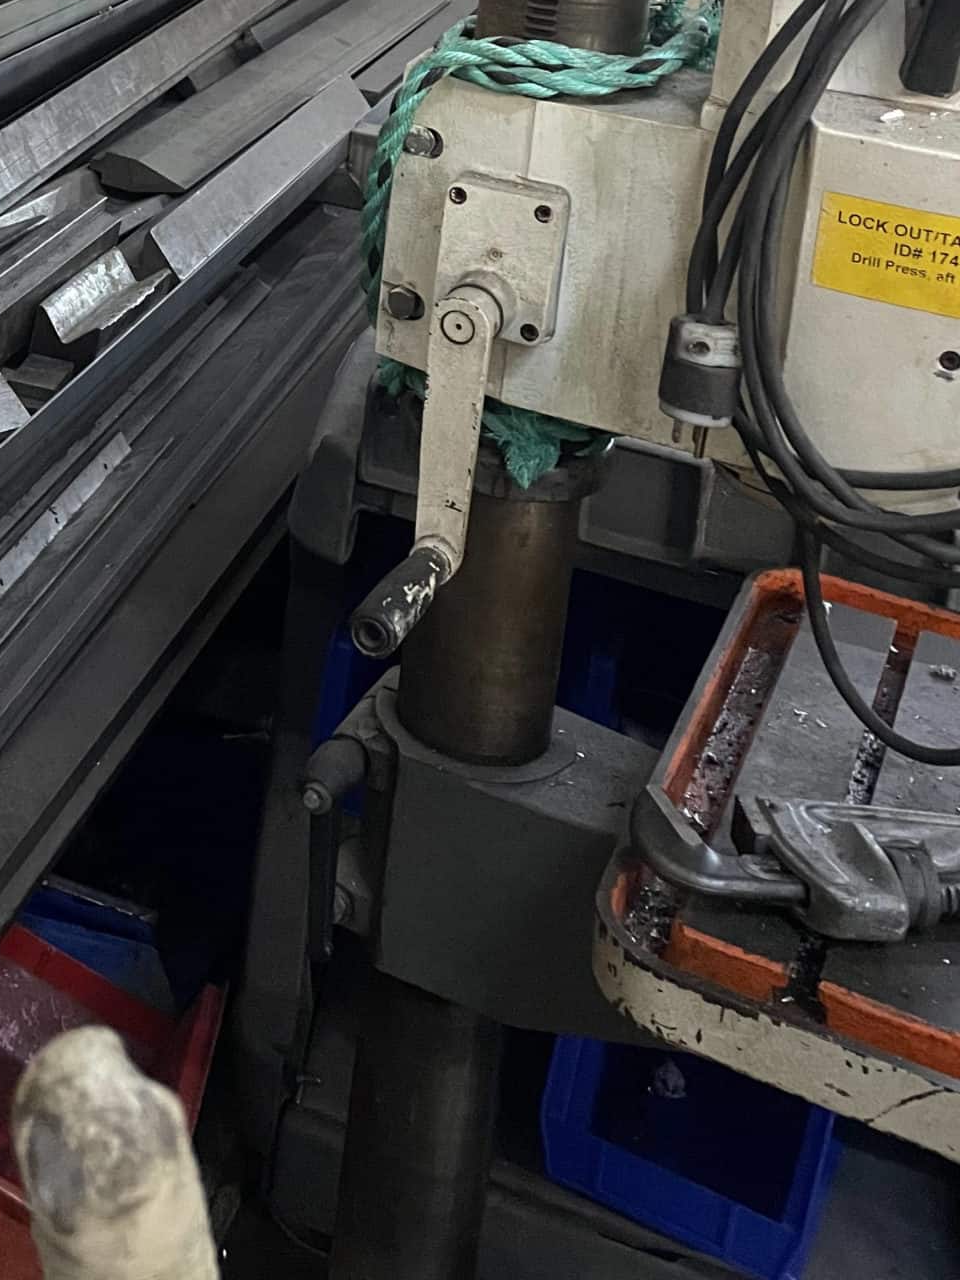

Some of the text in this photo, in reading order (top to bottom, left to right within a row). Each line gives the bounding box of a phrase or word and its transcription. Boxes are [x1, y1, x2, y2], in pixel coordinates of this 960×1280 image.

[837, 210, 889, 233] LOCK
[893, 242, 923, 259] ID#
[850, 251, 881, 268] Drill
